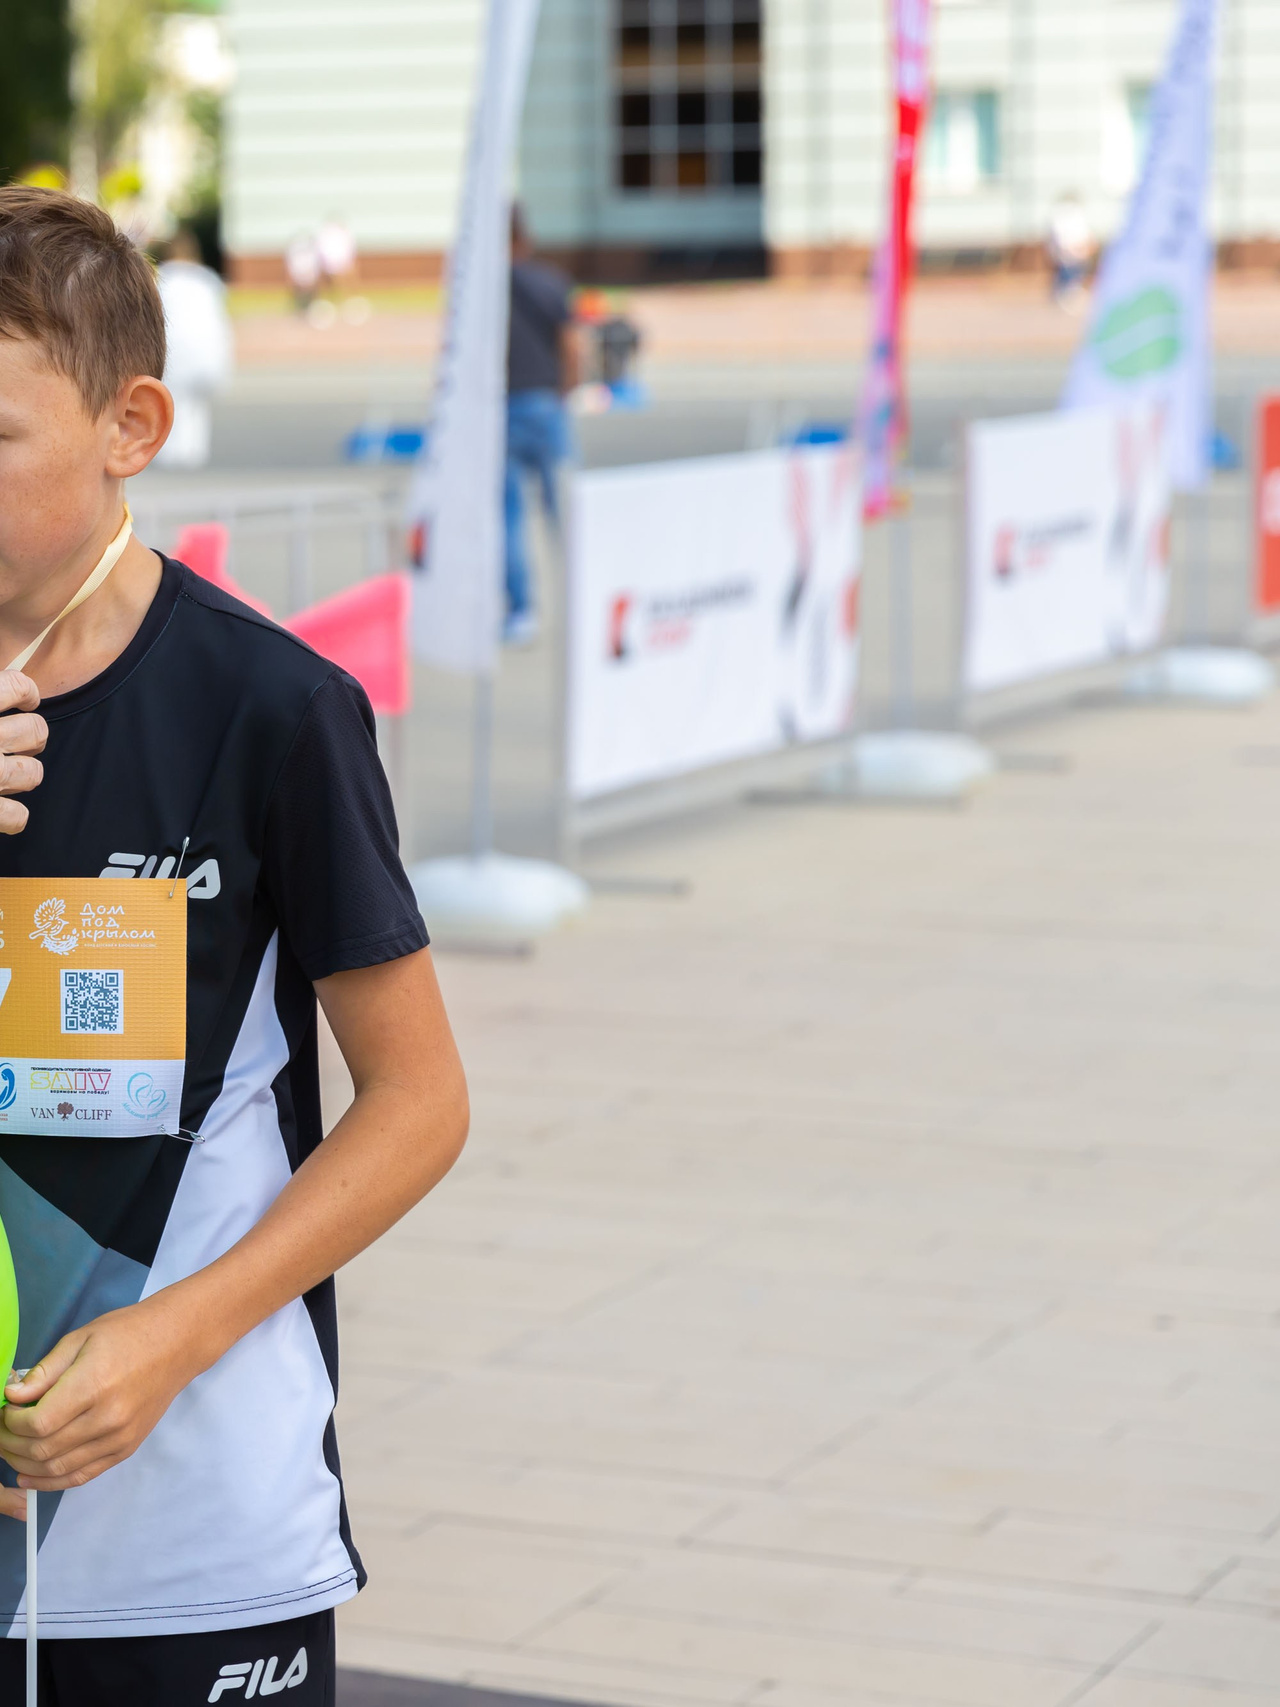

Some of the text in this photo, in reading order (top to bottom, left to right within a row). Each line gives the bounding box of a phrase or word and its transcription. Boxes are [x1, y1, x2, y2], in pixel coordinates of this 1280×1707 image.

[81, 917, 120, 929] под
[81, 929, 156, 942] крылом
[30, 1107, 55, 1119] VAN
[75, 1108, 112, 1121] CLIFF
[207, 1646, 309, 1704] FILA
